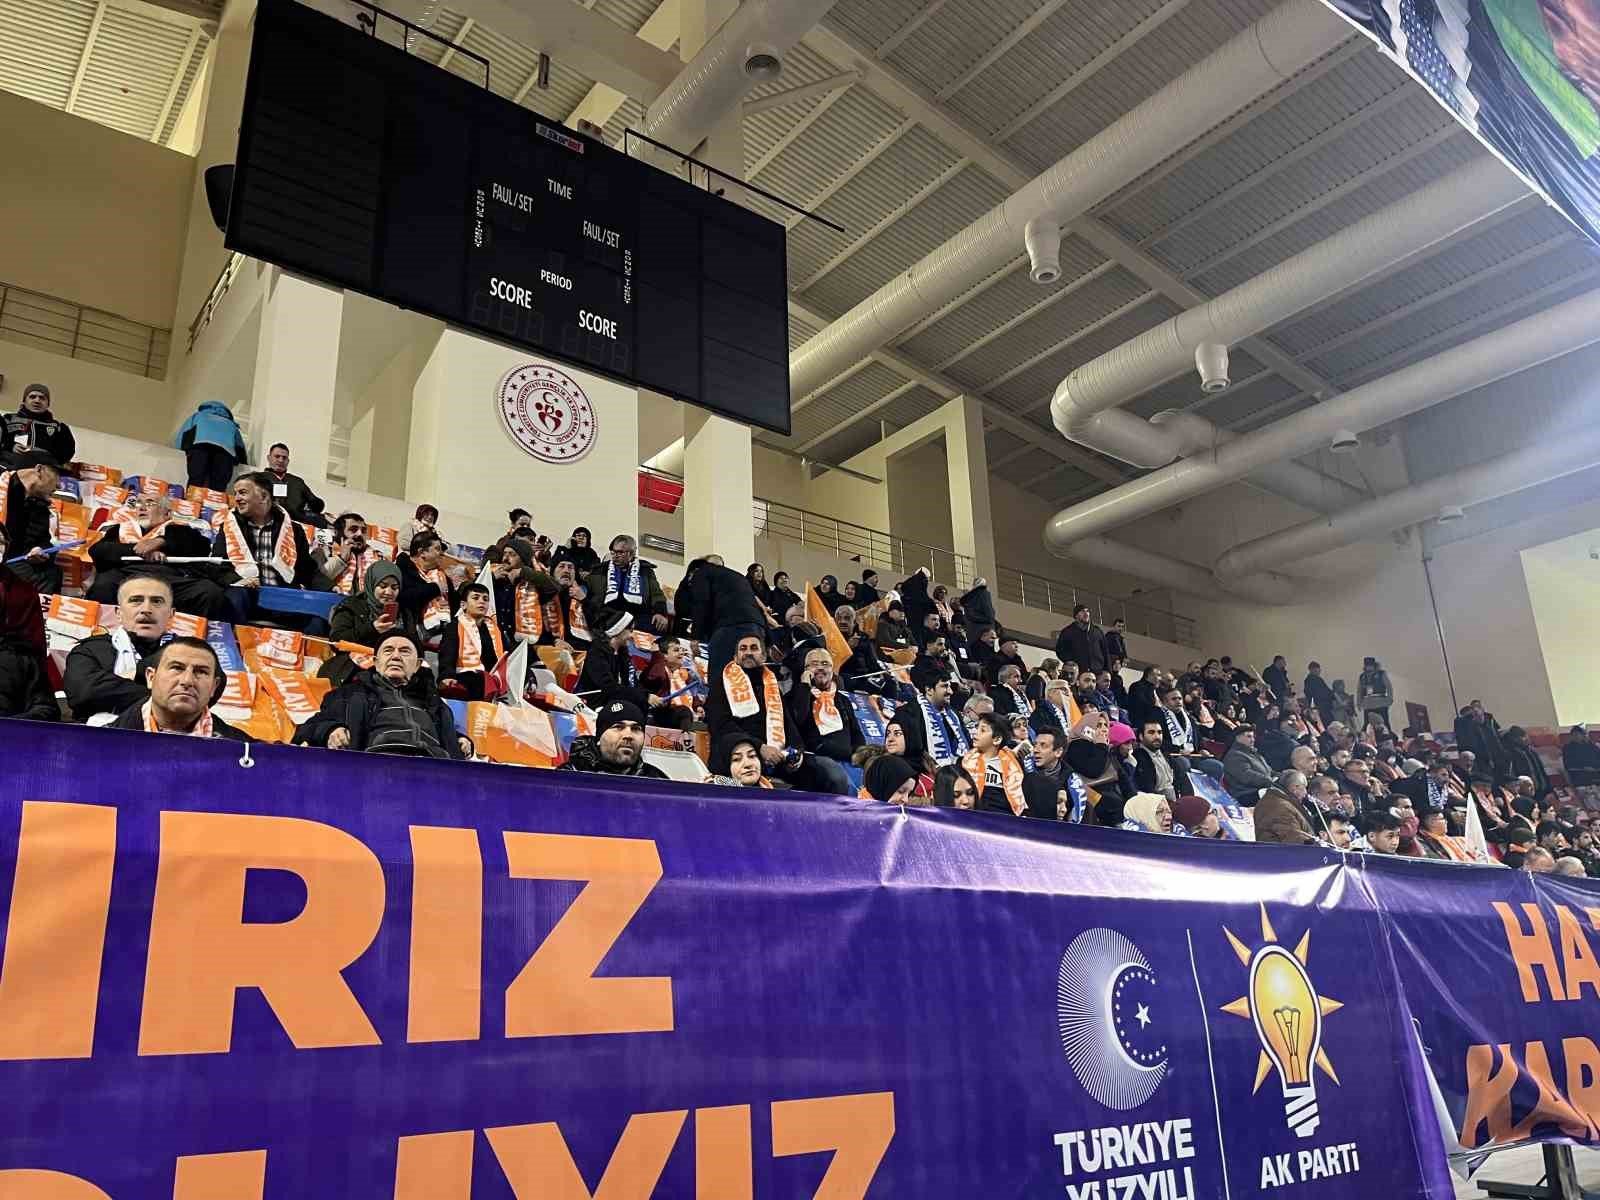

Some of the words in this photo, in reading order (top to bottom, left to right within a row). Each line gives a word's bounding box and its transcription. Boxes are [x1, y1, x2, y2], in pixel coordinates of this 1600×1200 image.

[492, 182, 534, 215] FAUL/SET
[548, 178, 573, 200] TIME
[583, 219, 620, 250] FAUL/SET
[489, 277, 533, 310] SCORE
[540, 268, 573, 291] PERIOD
[578, 309, 618, 340] SCORE
[1490, 901, 1600, 1003] HA
[1054, 1118, 1195, 1176] TÜRKİYE
[1261, 1152, 1295, 1189] AK
